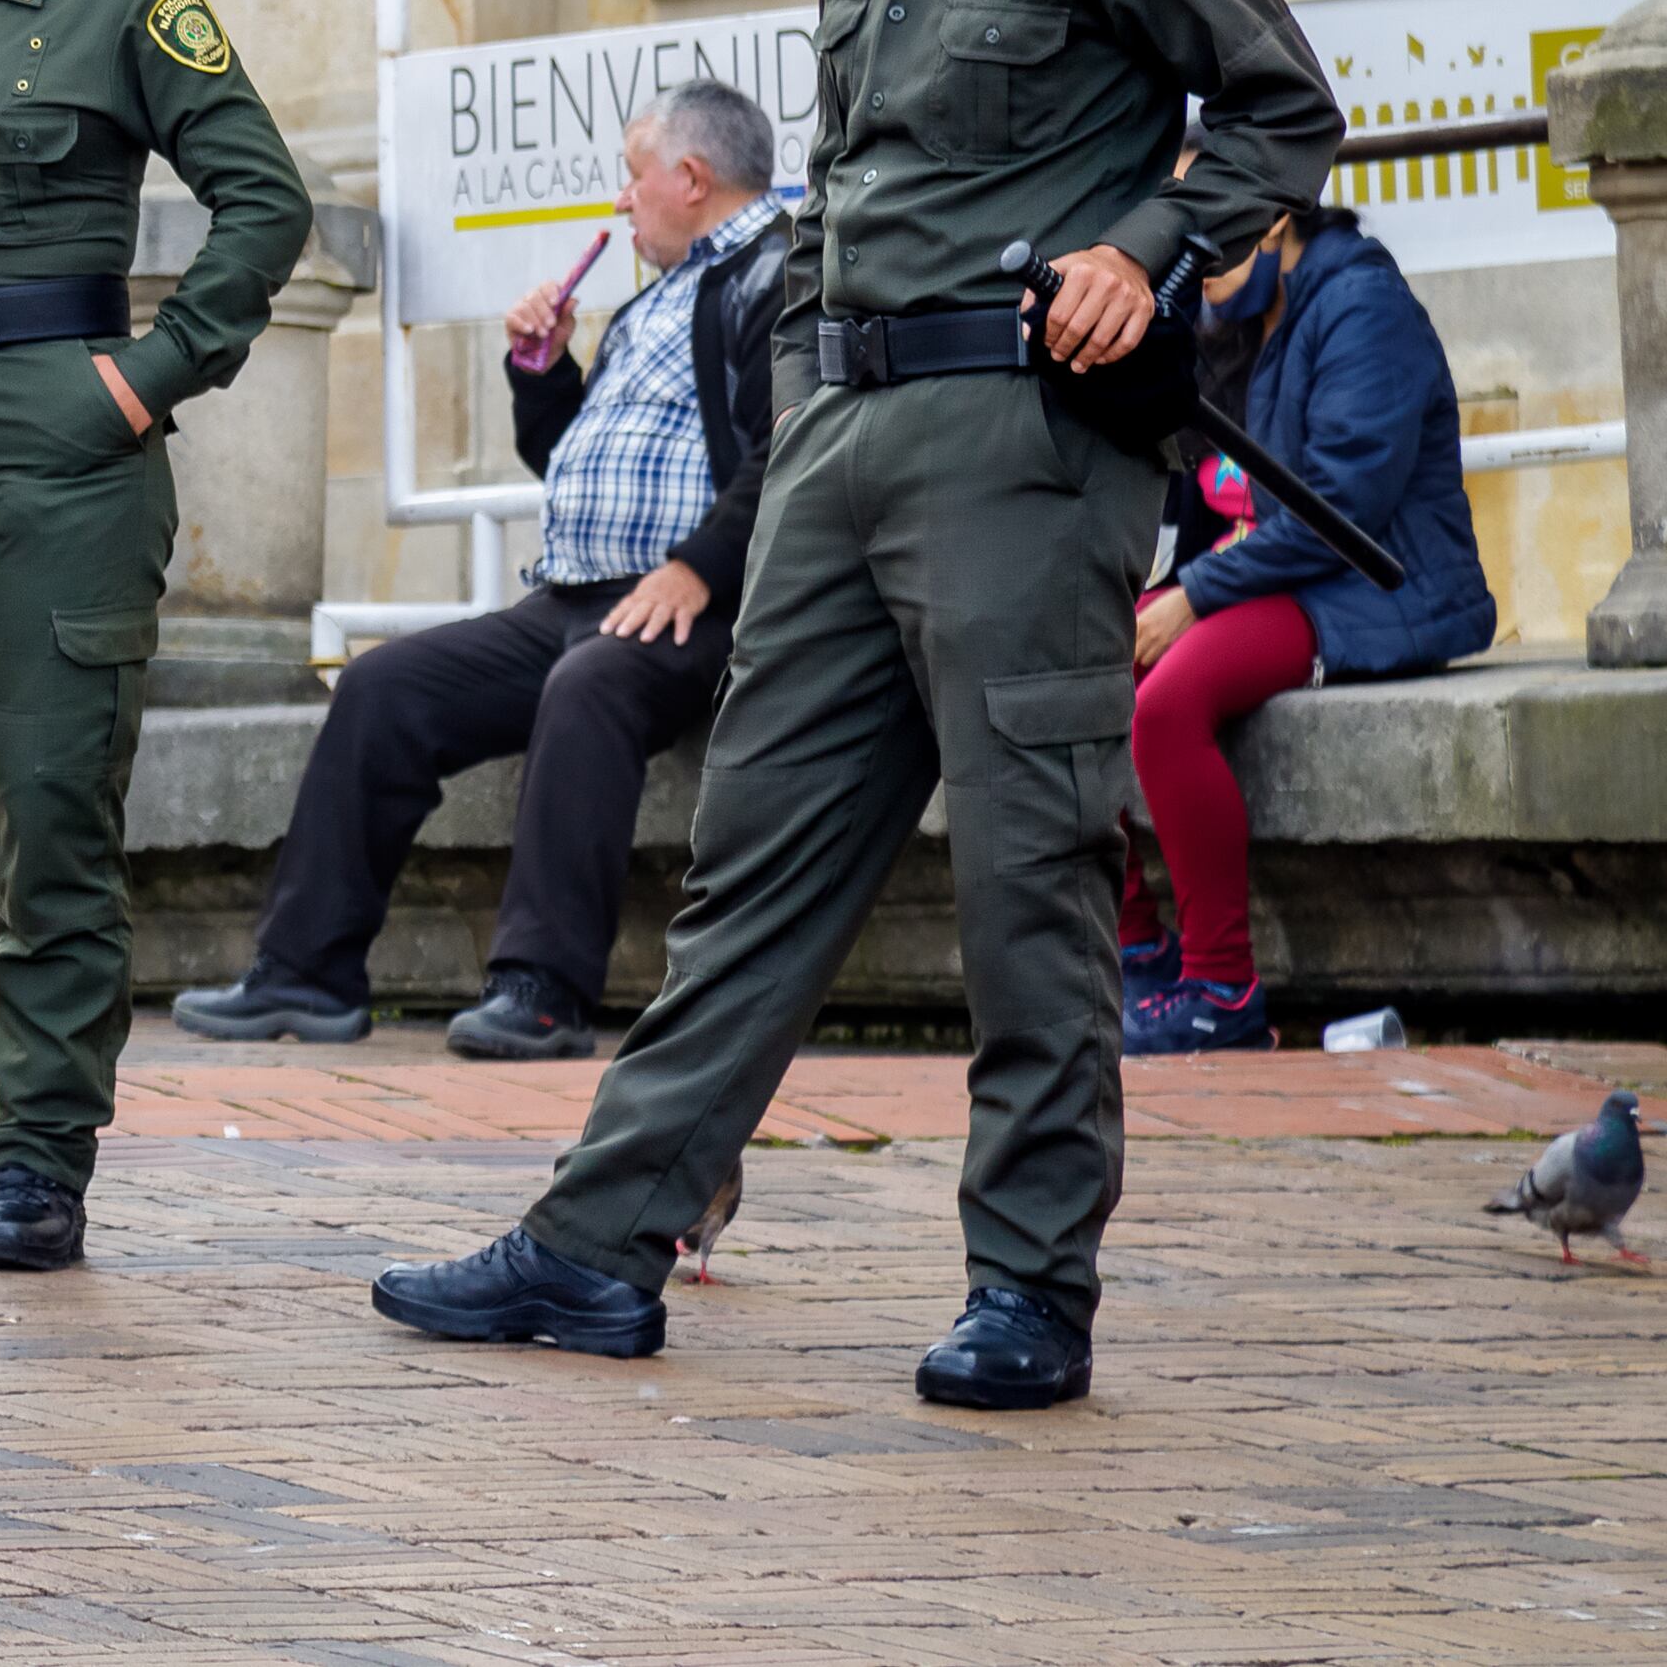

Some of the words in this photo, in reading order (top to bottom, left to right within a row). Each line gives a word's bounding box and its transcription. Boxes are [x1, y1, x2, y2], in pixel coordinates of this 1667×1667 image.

[450, 28, 819, 157] BIENVENID
[453, 167, 471, 207] A
[480, 164, 517, 205] LA
[524, 156, 606, 201] CASA
